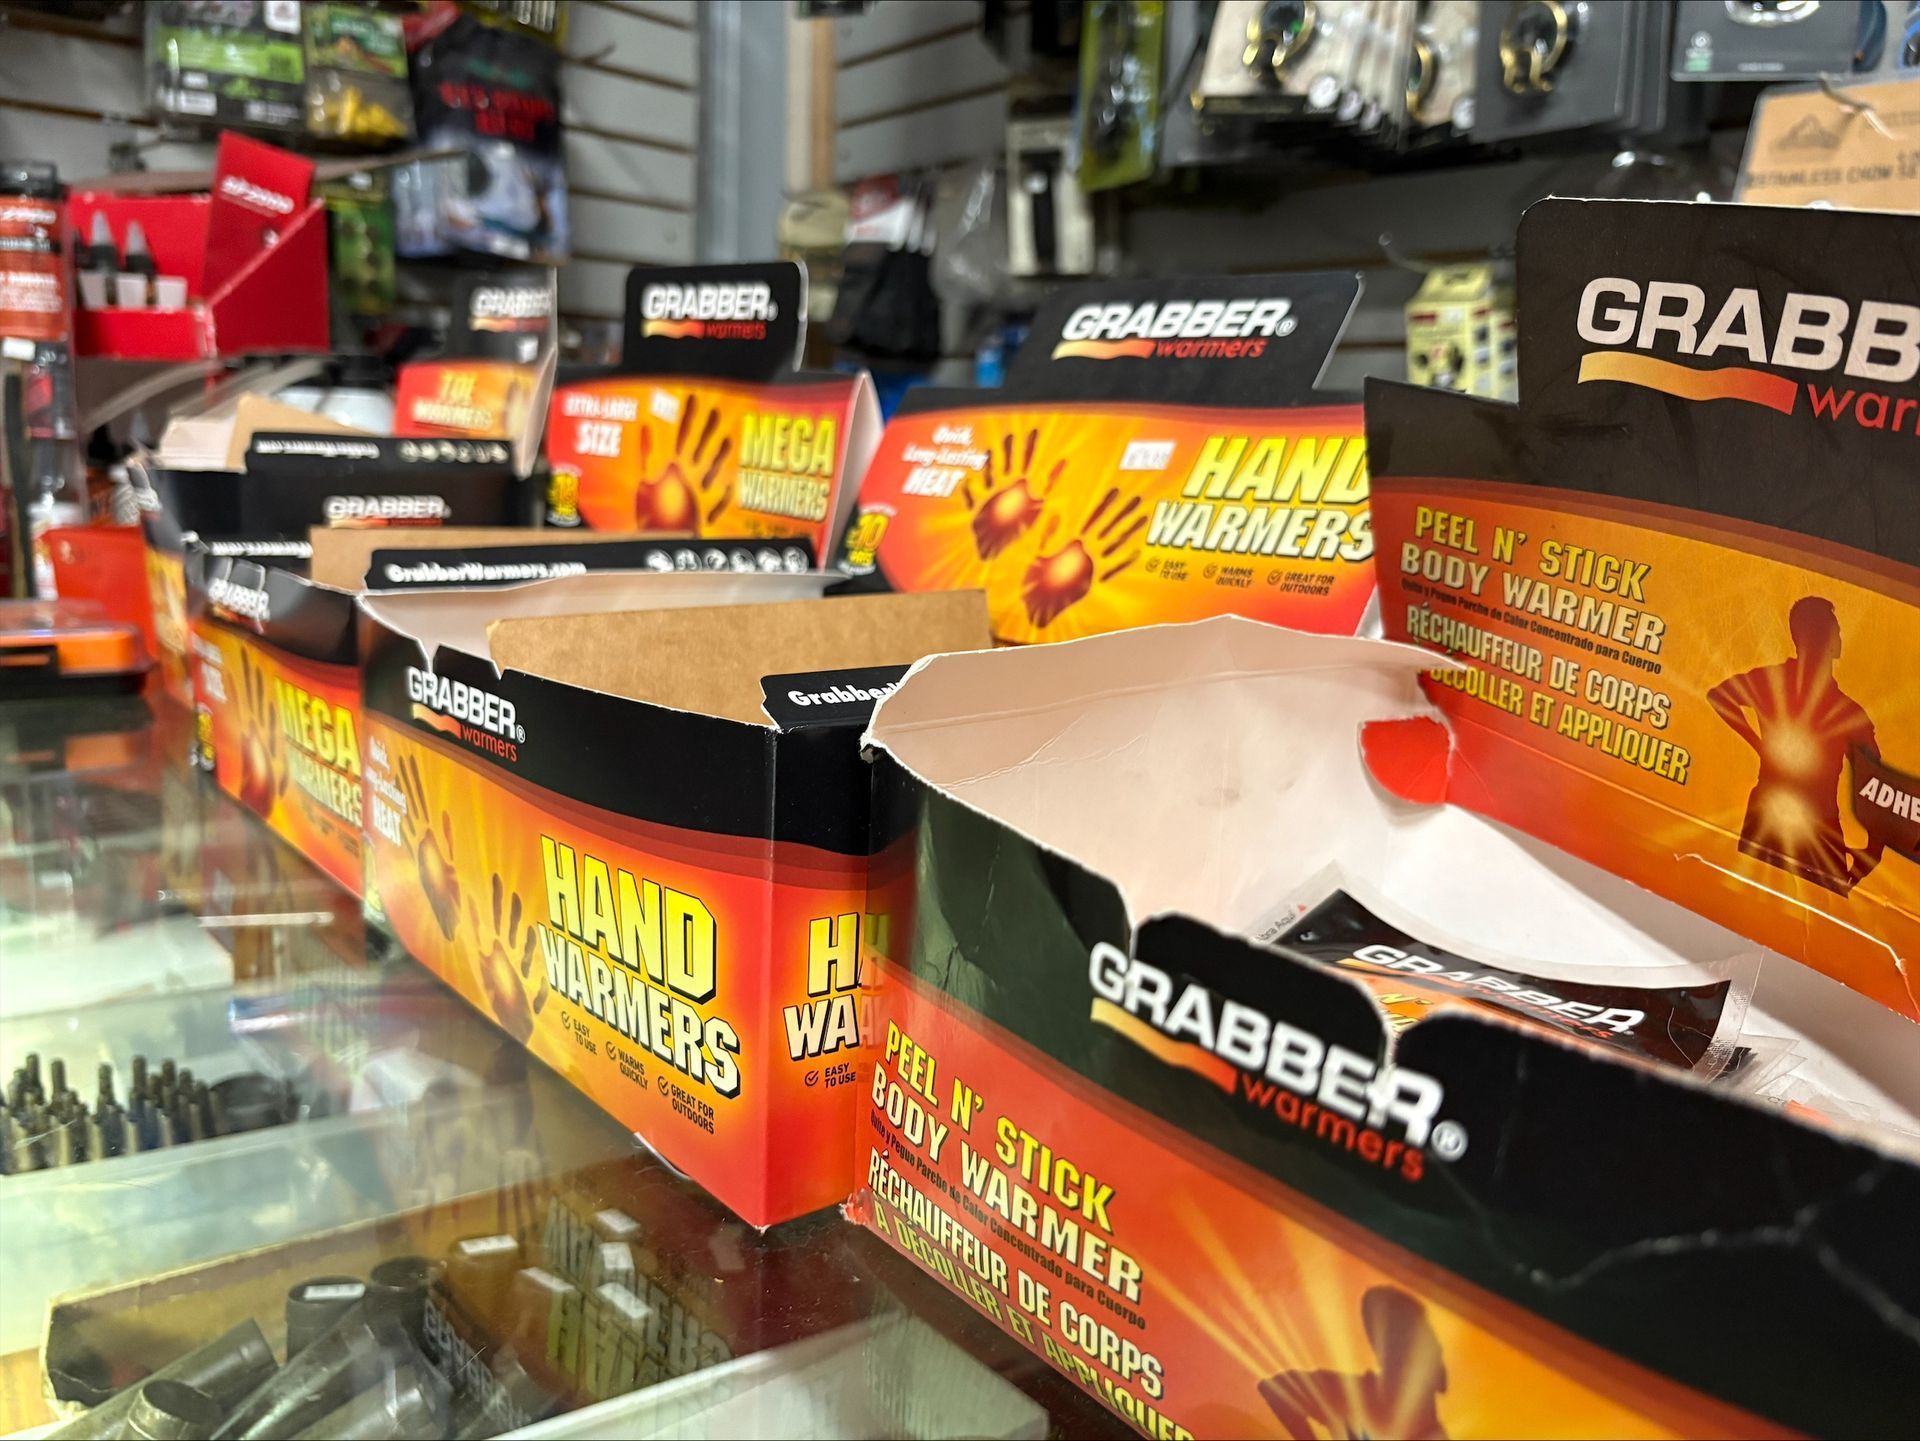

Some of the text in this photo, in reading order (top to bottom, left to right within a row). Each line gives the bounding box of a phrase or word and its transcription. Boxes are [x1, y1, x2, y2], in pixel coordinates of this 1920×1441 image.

[1155, 336, 1267, 358] warmers
[1807, 383, 1920, 437] war
[576, 421, 622, 457] SIZE
[740, 414, 837, 478] MEGA
[738, 470, 829, 522] WARMERS
[901, 465, 966, 497] HEAT
[1181, 436, 1369, 504] HAND
[1146, 500, 1375, 562] WARMERS
[1415, 506, 1478, 554] PEEL
[1539, 539, 1652, 603] STICK
[1216, 577, 1251, 588] QUICKLY
[1221, 567, 1254, 577] WARMS
[1280, 582, 1330, 596] OUTDOORS
[1284, 571, 1336, 586] GREAT FOR
[1400, 541, 1666, 655] BODY WARMER
[1407, 602, 1671, 730] RÉCHAUFFEUR DE CORPS
[1503, 610, 1529, 629] Calor
[1530, 620, 1593, 652] Concentrado
[1595, 644, 1619, 661] para
[1621, 650, 1662, 676] Cuerpo
[274, 675, 362, 782] MEGA
[462, 725, 517, 762] warmers
[1529, 691, 1554, 727] ET
[1557, 704, 1690, 785] APPLIQUER
[541, 834, 716, 1005] HAND
[537, 921, 740, 1099] WARMERS
[573, 1018, 590, 1038] EASY
[575, 1032, 598, 1056] TO USE
[617, 1047, 645, 1075] WARMS
[825, 1062, 849, 1077] EASY
[619, 1062, 648, 1090] QUICKLY
[671, 1083, 715, 1120] GREAT FOR
[825, 1072, 856, 1088] TO USE
[672, 1098, 715, 1135] OUTDOORS
[885, 1018, 938, 1107] PEEL
[995, 1115, 1115, 1236] STICK
[1241, 1073, 1425, 1183] warmers
[871, 1060, 1143, 1305] BODY WARMER
[891, 1135, 915, 1167] Pegue
[917, 1157, 948, 1192] Parche
[949, 1184, 961, 1204] de
[962, 1194, 989, 1226] Calor
[990, 1218, 1062, 1278] Concentrado
[1065, 1274, 1094, 1299] para
[1097, 1289, 1145, 1330] Cuerpo
[867, 1146, 1164, 1400] RÉCHAUFFEUR DE CORPS
[893, 1213, 1003, 1322] DÉCOLLER
[1005, 1303, 1035, 1345] ET
